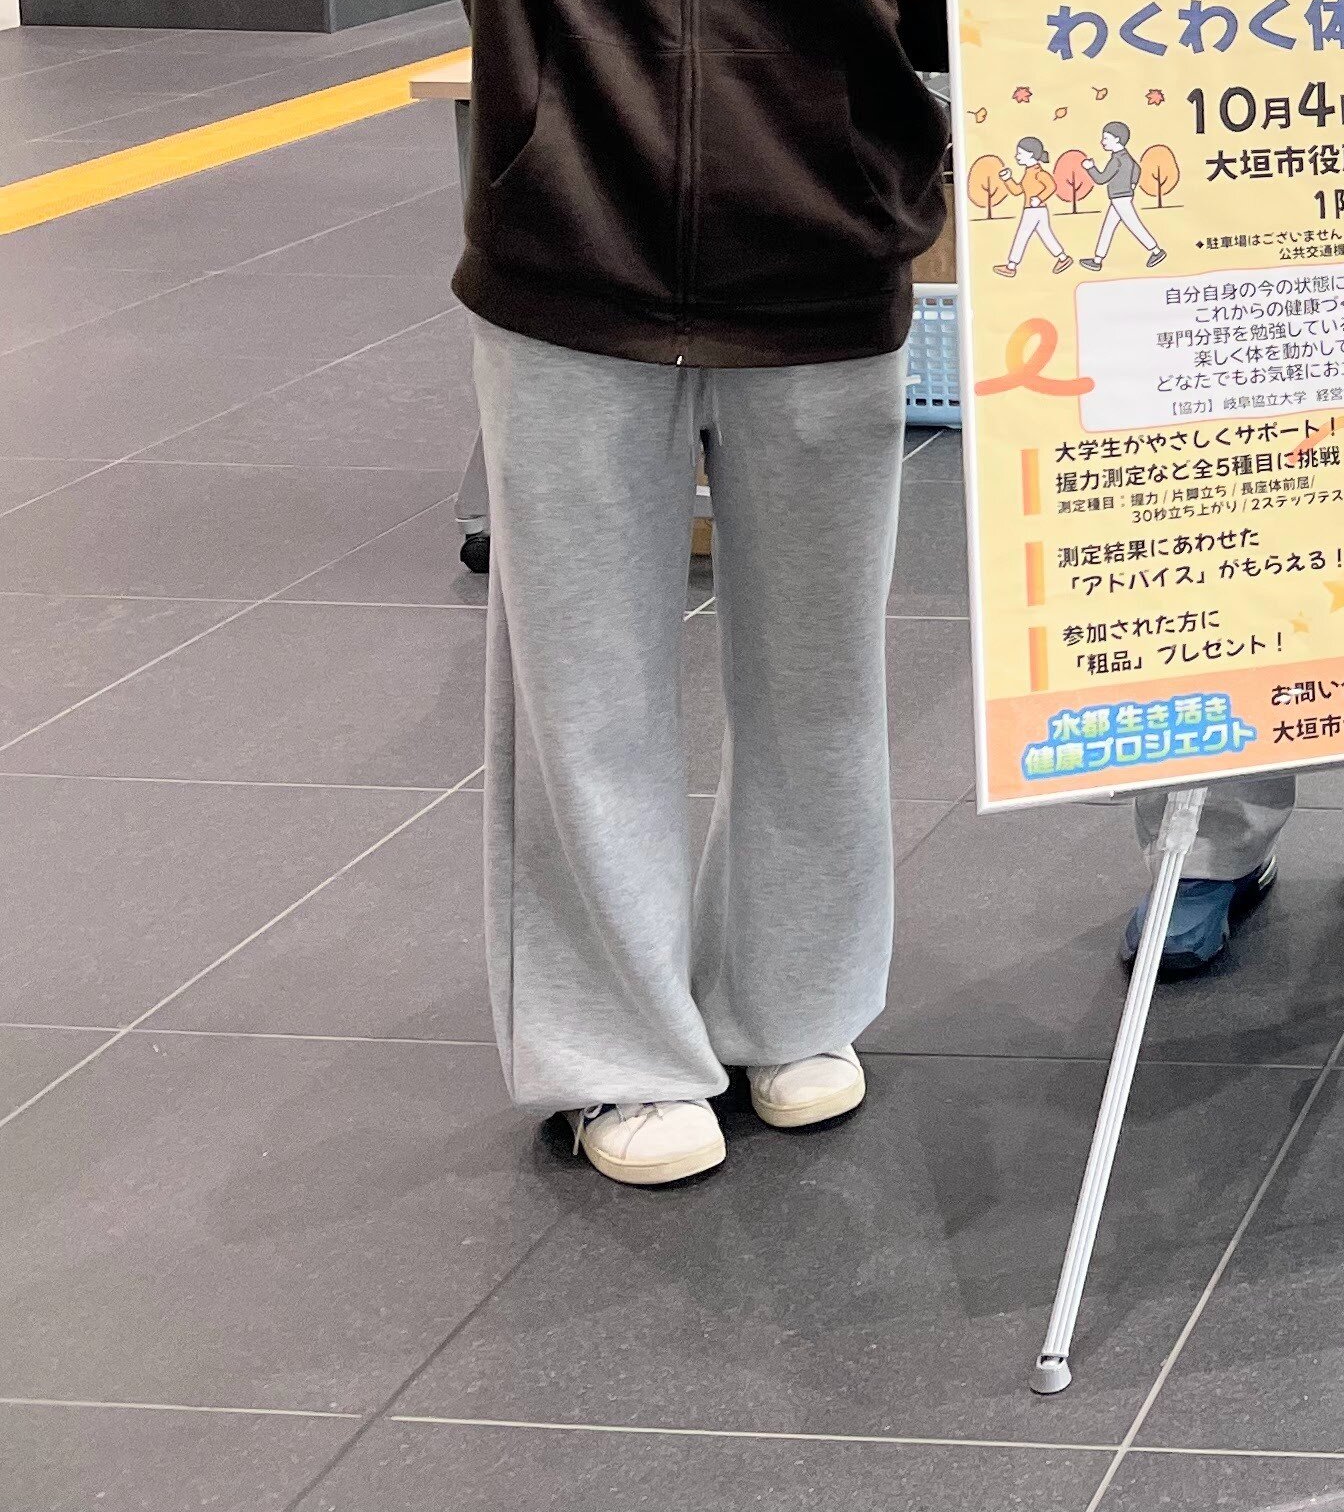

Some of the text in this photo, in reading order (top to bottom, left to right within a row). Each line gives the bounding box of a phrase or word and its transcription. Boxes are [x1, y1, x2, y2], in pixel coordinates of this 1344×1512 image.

[1055, 417, 1335, 463] 大学生がやさしくサポート！
[1055, 445, 1341, 494] 握力測定など全5種目に挑戦
[1057, 527, 1260, 568] 測定結果にあわせた
[1062, 610, 1220, 647] 参加された方に
[1025, 721, 1254, 775] 健康プロジェクト
